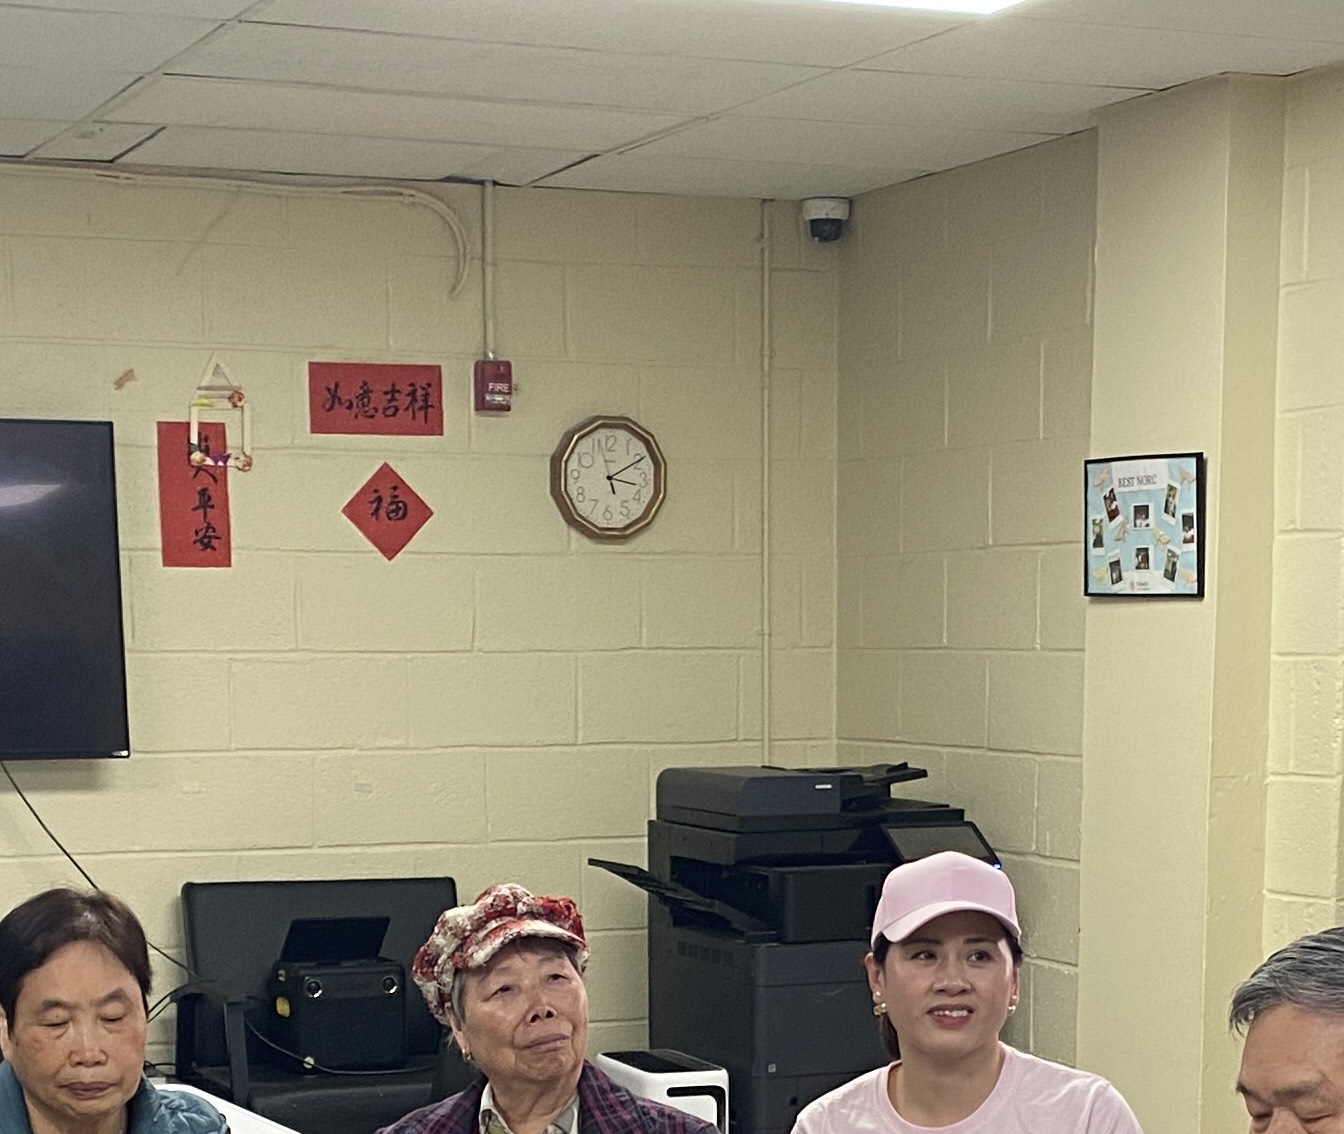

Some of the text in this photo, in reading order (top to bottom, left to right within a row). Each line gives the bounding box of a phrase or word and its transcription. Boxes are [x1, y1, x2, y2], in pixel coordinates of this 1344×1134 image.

[488, 382, 510, 393] FIRE
[322, 380, 435, 424] 如意吉祥
[605, 435, 617, 453] 12
[626, 438, 633, 456] 1
[577, 452, 594, 469] 10
[570, 469, 581, 485] 9
[639, 472, 648, 489] 3
[576, 486, 586, 503] 8
[633, 489, 642, 504] 4
[368, 485, 409, 522] 福
[589, 499, 599, 515] 7
[620, 500, 631, 517] 5
[603, 505, 613, 521] 6
